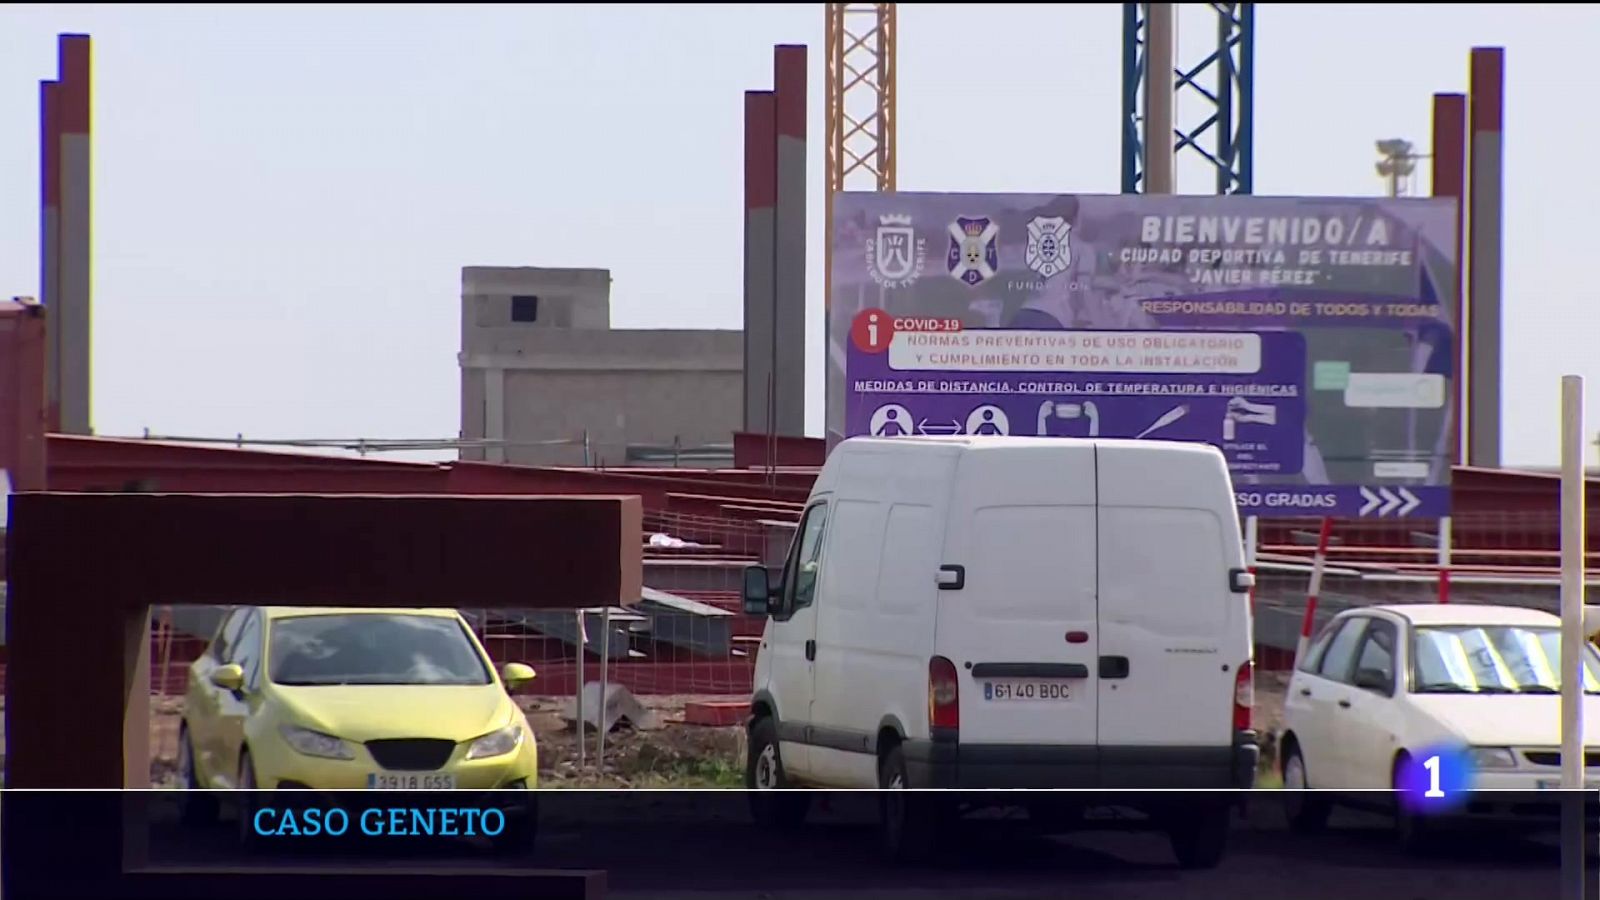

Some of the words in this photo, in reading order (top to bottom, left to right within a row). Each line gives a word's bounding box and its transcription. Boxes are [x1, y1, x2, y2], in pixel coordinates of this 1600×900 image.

[1141, 215, 1389, 246] BIENVENIDO/A
[1120, 248, 1182, 263] CIUDAD
[1189, 249, 1285, 264] DEPORTIVA
[1299, 250, 1321, 265] DE
[1329, 251, 1412, 266] TENERIFE
[1142, 301, 1286, 316] RESPONSABILIDAD
[1289, 303, 1312, 316] DE
[1314, 303, 1369, 316] TODOS
[1373, 305, 1383, 316] Y
[1387, 304, 1439, 317] TODAS
[894, 318, 960, 331] COVID-19
[907, 335, 970, 347] NORMAS
[976, 335, 1077, 348] PREVENTIVAS
[1082, 337, 1101, 348] DE
[1106, 337, 1137, 348] USO
[1142, 337, 1245, 350] OBLIGATORIO
[916, 354, 923, 364] Y
[929, 353, 1040, 366] CUMPLIMIENTO
[1046, 355, 1066, 366] EN
[1072, 355, 1110, 367] TODA
[1115, 355, 1134, 367] LA
[854, 379, 914, 392] MEDIDAS
[918, 380, 937, 392] DE
[1019, 382, 1080, 393] CONTROL
[1085, 383, 1102, 394] DE
[1107, 383, 1204, 395] TEMPERATURA
[1208, 384, 1217, 395] E
[1264, 492, 1337, 507] GRADAS
